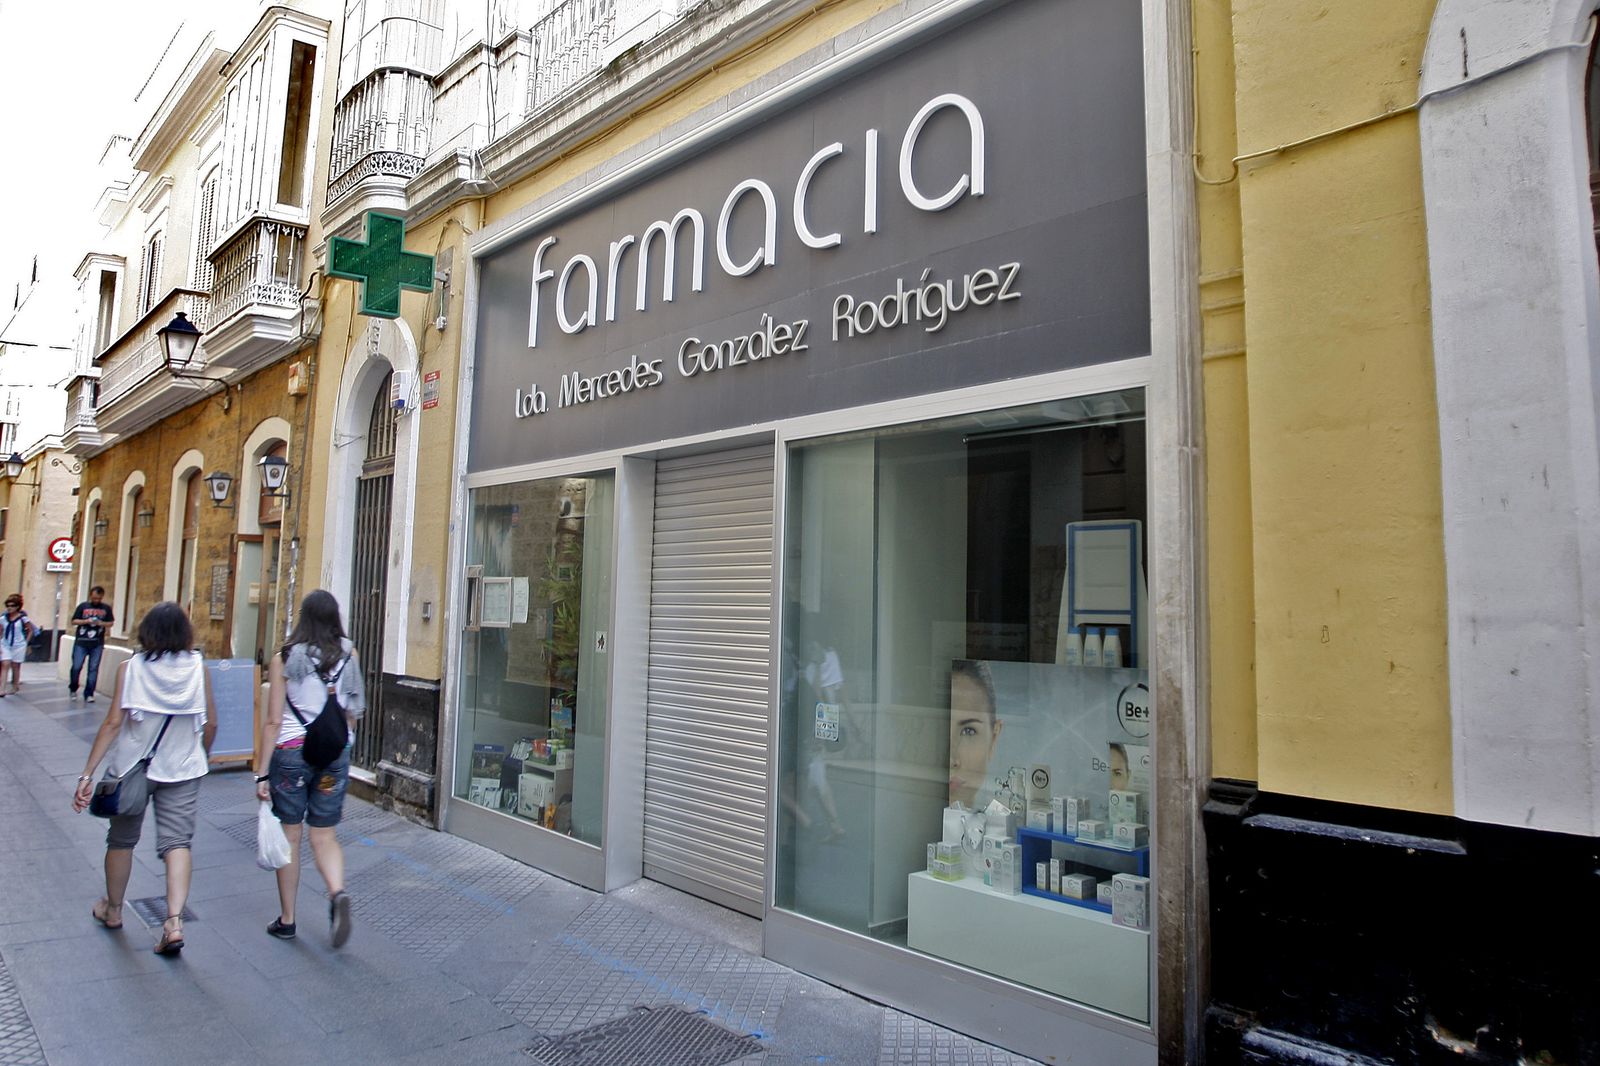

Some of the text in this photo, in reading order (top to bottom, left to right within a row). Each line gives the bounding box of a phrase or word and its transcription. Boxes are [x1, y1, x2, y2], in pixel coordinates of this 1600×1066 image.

[527, 93, 985, 349] farmacia
[558, 355, 664, 408] Mercedes
[677, 312, 809, 377] González
[832, 262, 1022, 341] Rodríguez
